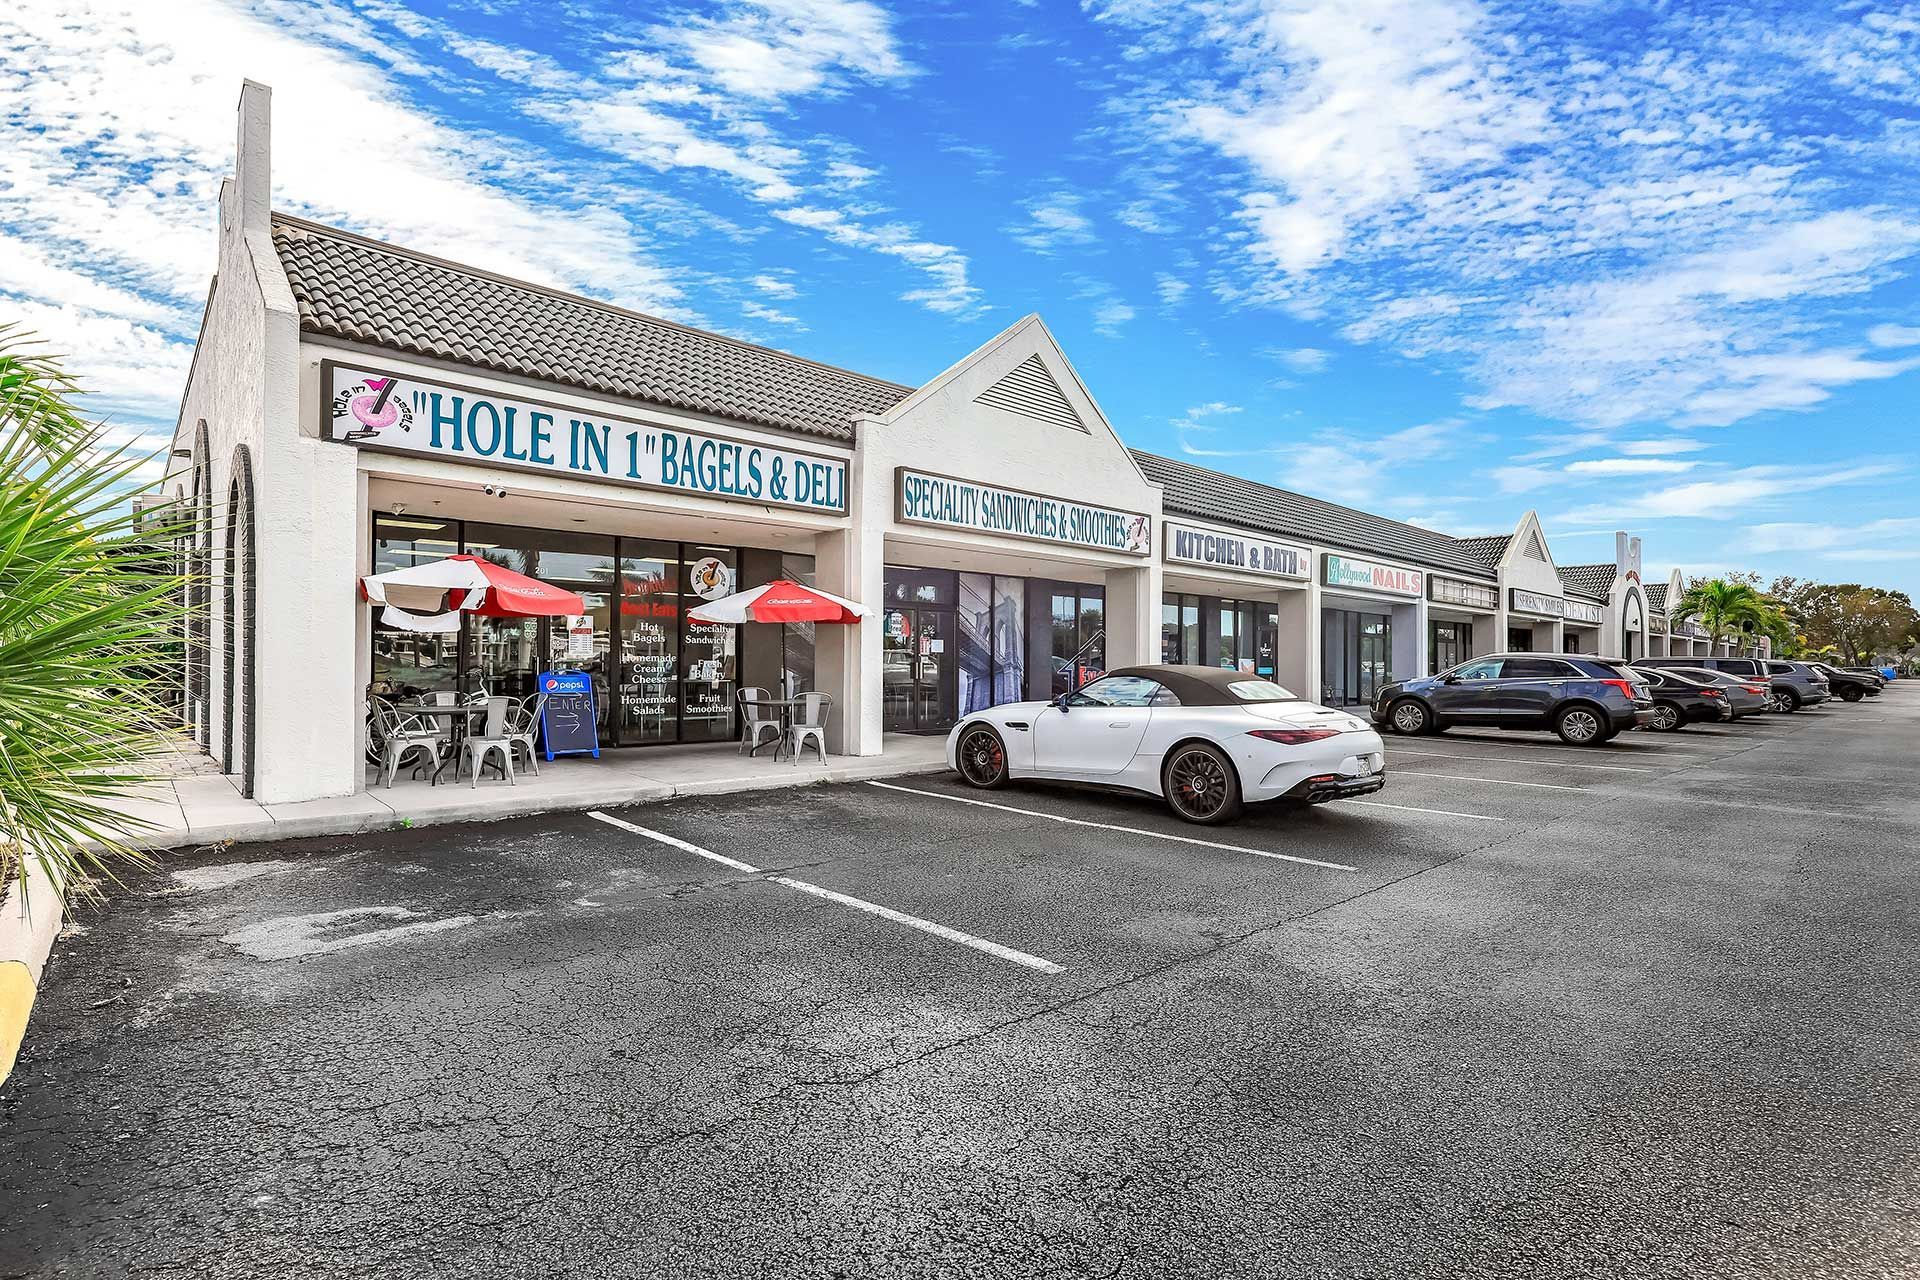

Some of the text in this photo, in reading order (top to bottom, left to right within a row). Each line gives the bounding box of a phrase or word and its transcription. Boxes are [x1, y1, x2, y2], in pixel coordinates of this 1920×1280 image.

[569, 419, 611, 474] IN
[661, 432, 762, 498] BAGELS
[769, 456, 788, 501] &
[794, 460, 844, 508] DELI
[904, 476, 980, 526] SPECIALITY
[981, 490, 1057, 538] SANDWICHES
[1059, 505, 1068, 539] &
[1070, 507, 1126, 548] SMOOTHIES
[1175, 530, 1245, 567] KITCHEN
[1249, 547, 1261, 569] &
[1263, 546, 1298, 574] BATH
[535, 567, 549, 575] 201
[1329, 557, 1421, 593] Hollywood NAILS
[1566, 602, 1602, 622] DENTIST
[640, 622, 659, 632] Hot
[690, 624, 730, 634] Specialty
[633, 633, 665, 643] Bagels
[685, 634, 735, 645] Sandwiches
[621, 653, 677, 663] Homemade
[633, 663, 665, 673] Cream
[698, 659, 722, 669] Fresh
[631, 674, 667, 684] Cheese
[694, 669, 726, 680] Bakery
[559, 680, 584, 690] pepsi
[621, 694, 677, 705] Homemade
[699, 694, 721, 703] Fruit
[632, 706, 665, 715] Salads
[686, 704, 733, 714] Smoothies
